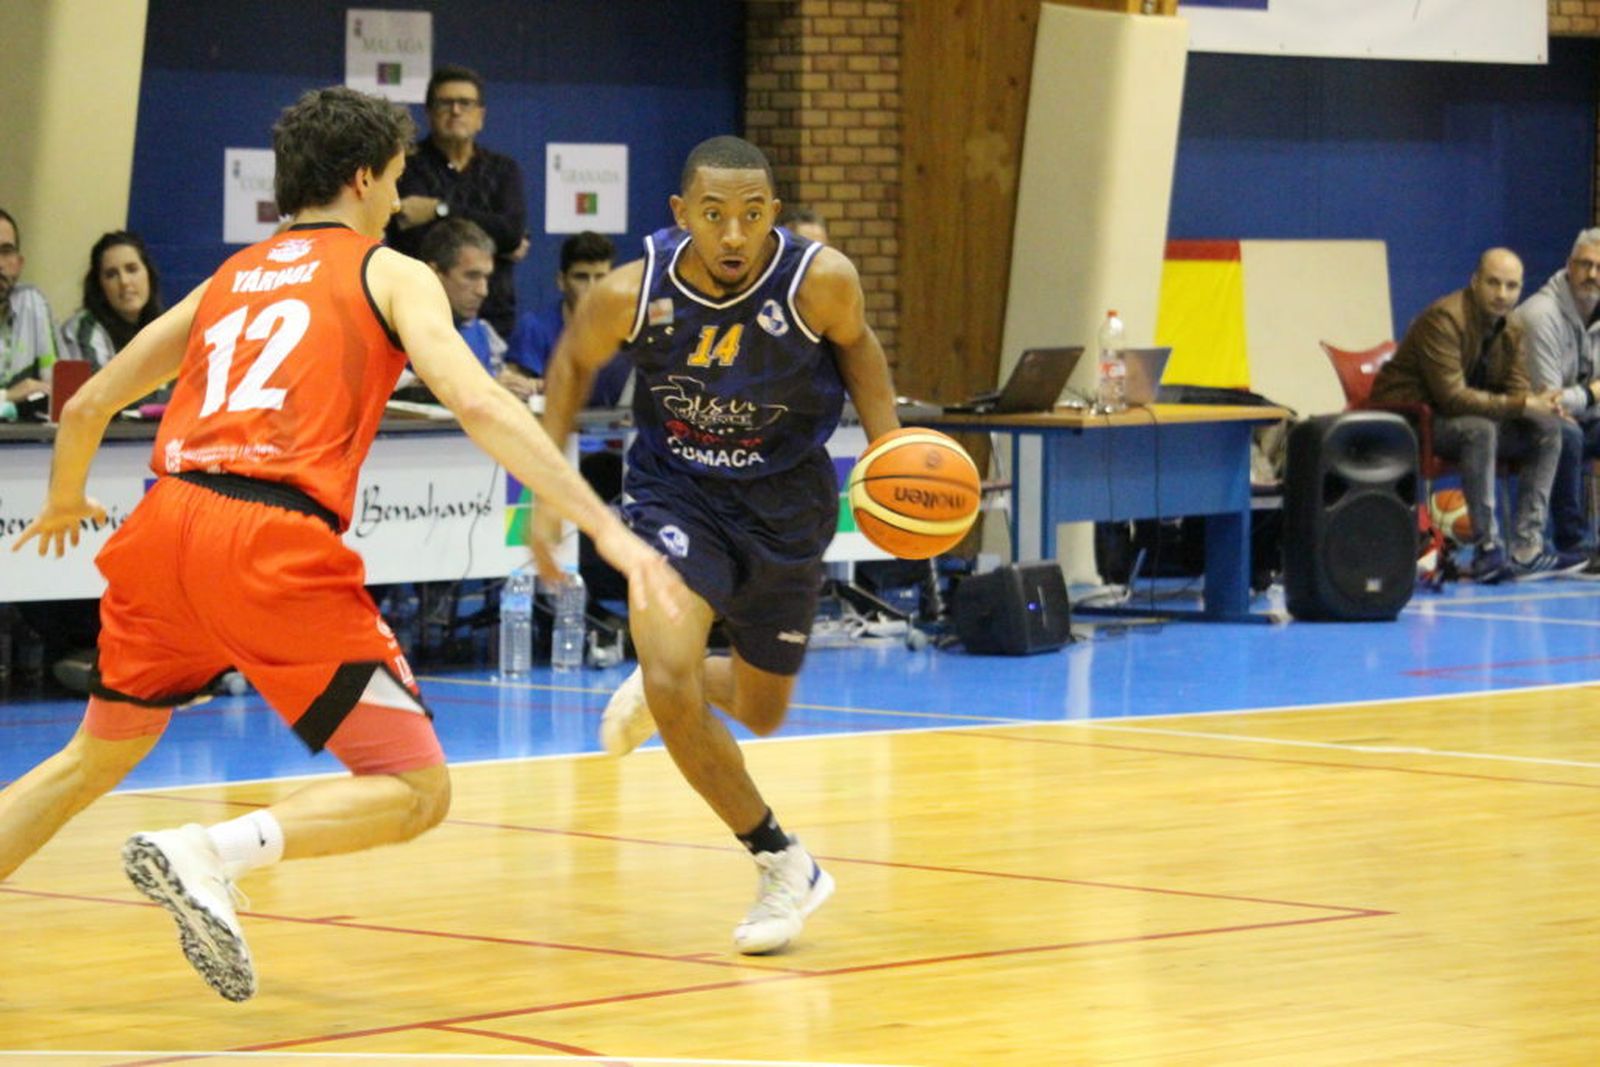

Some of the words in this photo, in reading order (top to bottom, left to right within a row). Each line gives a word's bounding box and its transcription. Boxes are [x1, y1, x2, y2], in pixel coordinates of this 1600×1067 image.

[560, 169, 620, 184] GRANADA
[198, 298, 311, 418] 12
[687, 323, 744, 368] 14
